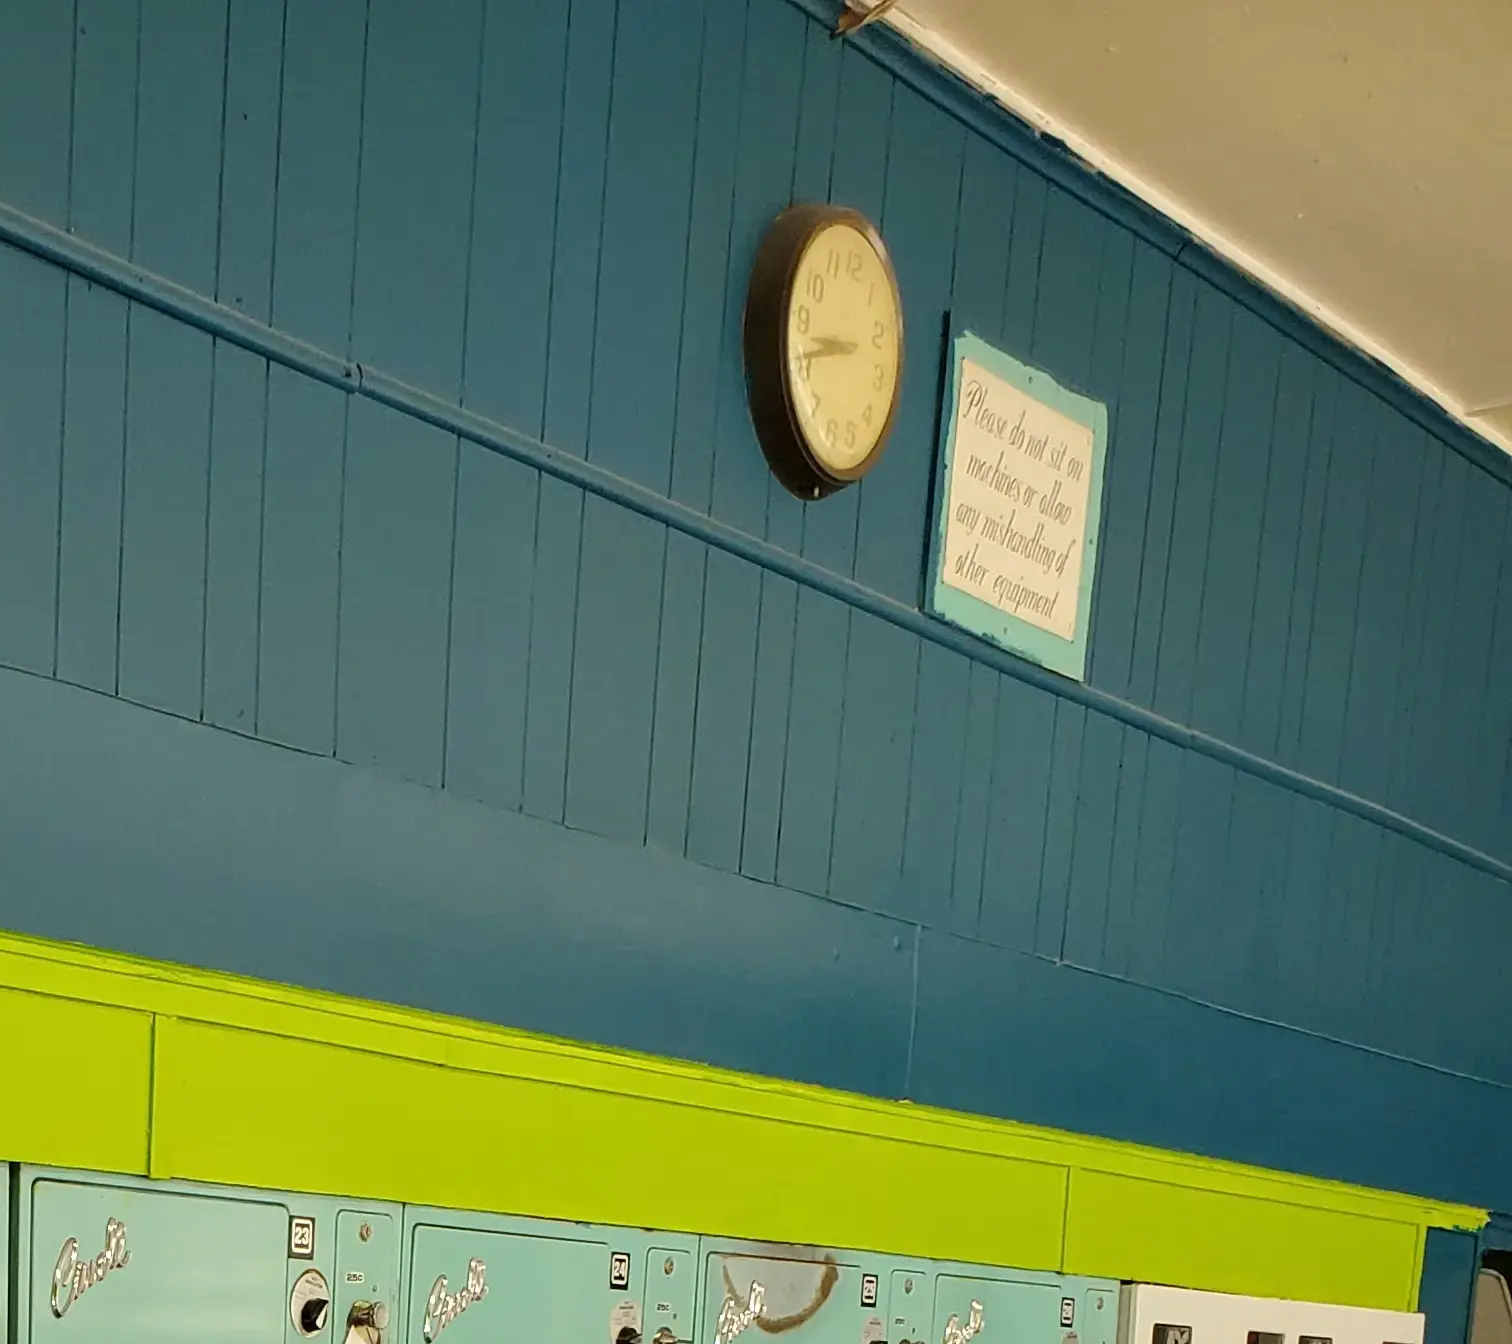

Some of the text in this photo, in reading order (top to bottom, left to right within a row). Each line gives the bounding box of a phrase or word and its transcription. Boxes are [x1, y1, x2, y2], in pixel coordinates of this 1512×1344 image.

[827, 248, 839, 279] 11
[846, 250, 863, 283] 12
[806, 268, 824, 303] 10
[867, 281, 874, 306] 1
[797, 304, 810, 335] 9
[872, 320, 884, 350] 2
[872, 364, 884, 392] 3
[811, 390, 821, 418] 7
[861, 403, 872, 428] 4
[825, 419, 838, 449] 6
[844, 420, 857, 449] 5
[962, 379, 1084, 482] Please do not sit on
[966, 450, 1072, 525] machines or allow
[955, 503, 1076, 578] any mishandling of
[955, 543, 1059, 618] other equipment
[295, 1227, 309, 1245] 23
[614, 1261, 625, 1278] 24
